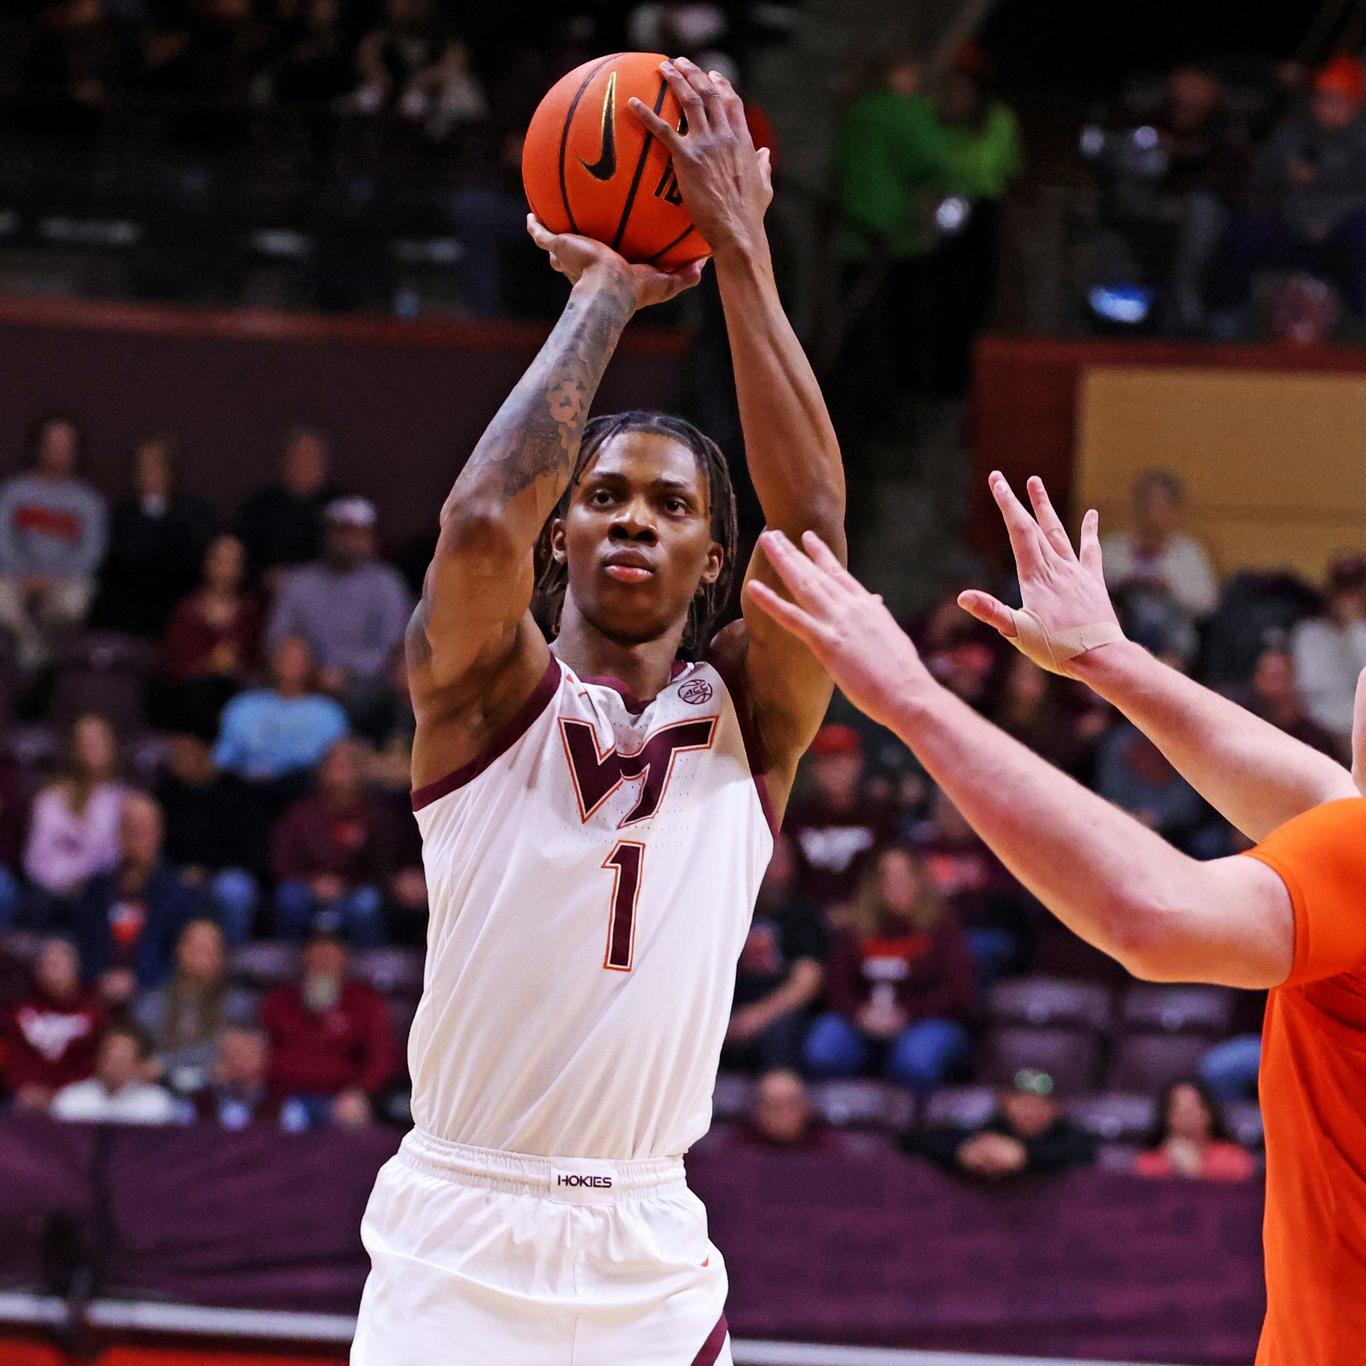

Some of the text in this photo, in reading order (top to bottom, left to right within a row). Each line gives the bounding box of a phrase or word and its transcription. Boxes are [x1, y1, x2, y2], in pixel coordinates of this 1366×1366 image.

[558, 715, 719, 830] VT
[601, 840, 645, 972] 1
[557, 1174, 612, 1188] HOKIES
